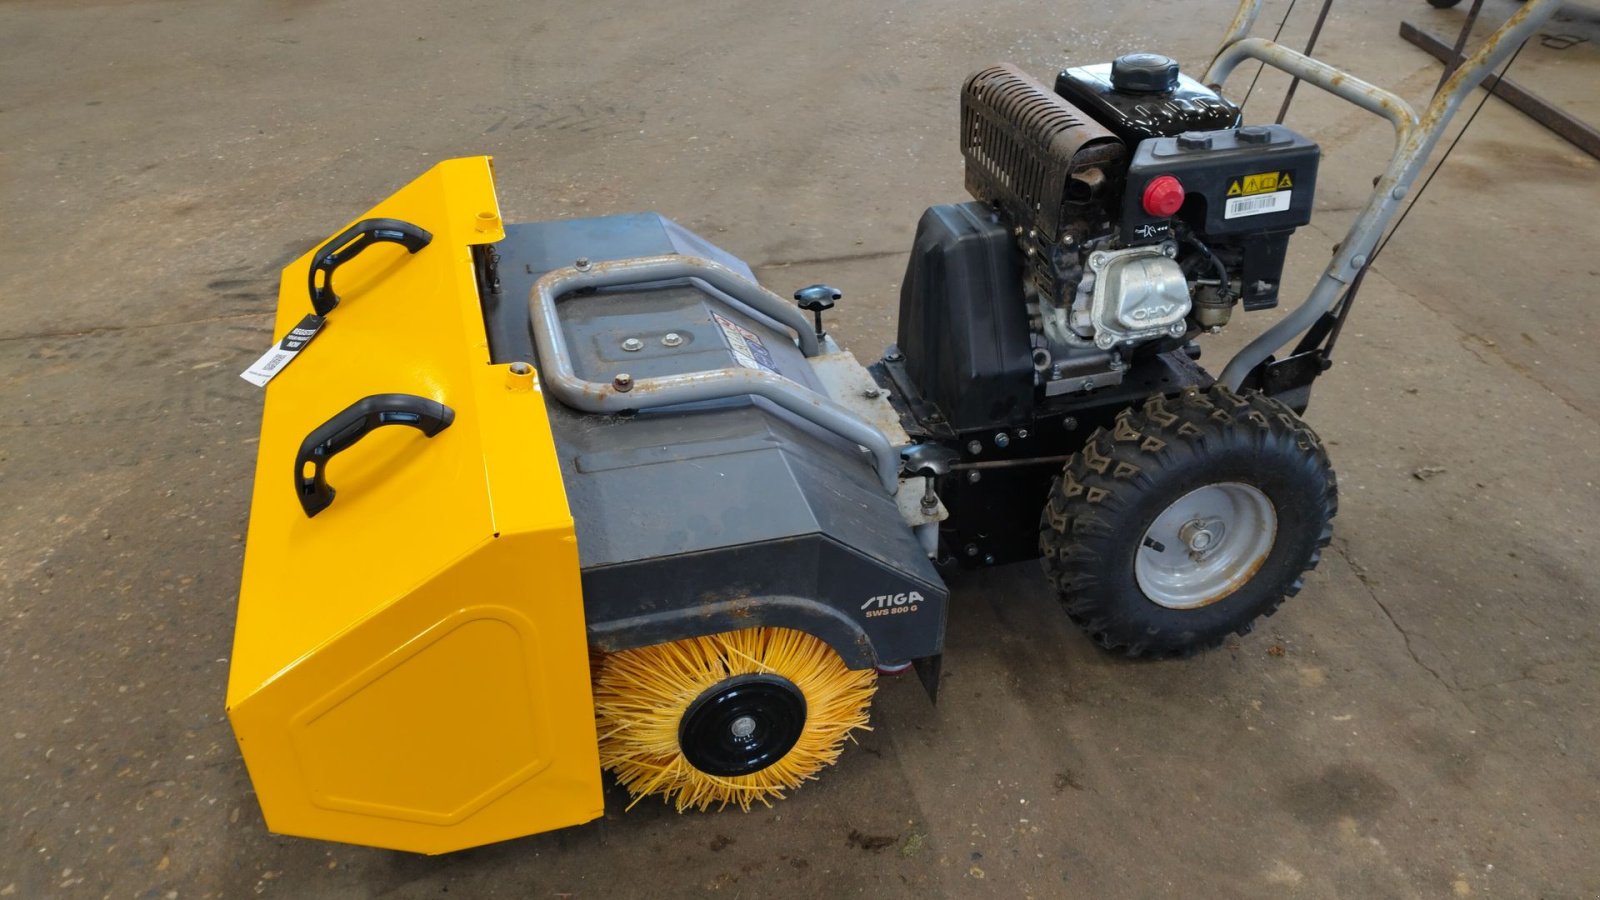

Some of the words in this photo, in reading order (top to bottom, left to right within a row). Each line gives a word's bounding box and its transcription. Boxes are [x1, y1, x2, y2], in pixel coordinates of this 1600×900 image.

[1132, 303, 1175, 320] OHV
[860, 591, 924, 609] STIGA
[865, 608, 889, 618] SWS
[890, 606, 909, 614] 800
